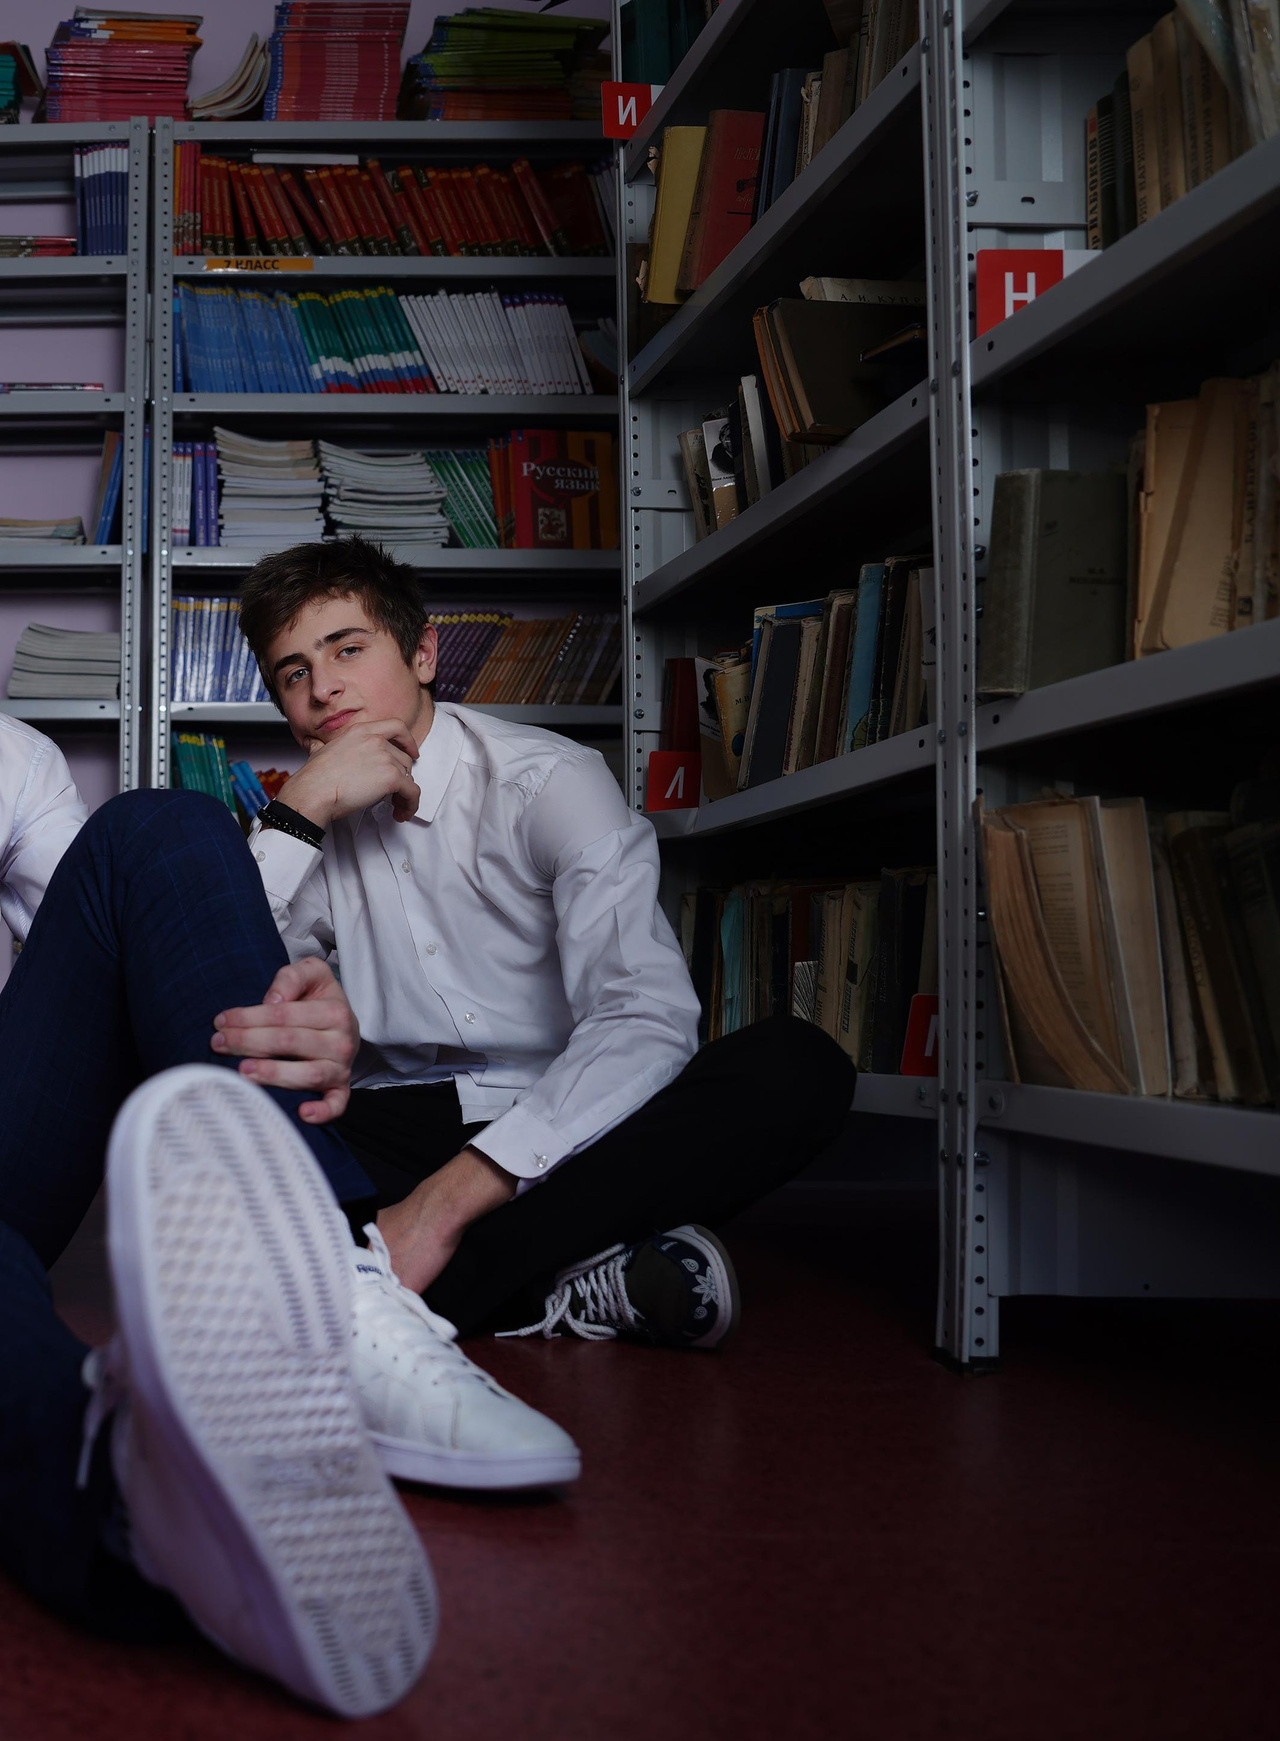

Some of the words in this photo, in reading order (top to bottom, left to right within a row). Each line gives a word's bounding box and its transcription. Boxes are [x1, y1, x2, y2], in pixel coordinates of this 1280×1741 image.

[618, 95, 637, 126] И
[224, 260, 231, 269] 7
[236, 260, 279, 270] КЛАСС
[878, 295, 926, 304] КУПР
[1005, 272, 1036, 319] Н
[521, 462, 599, 479] Русский
[554, 478, 600, 490] язык
[664, 766, 685, 799] Л
